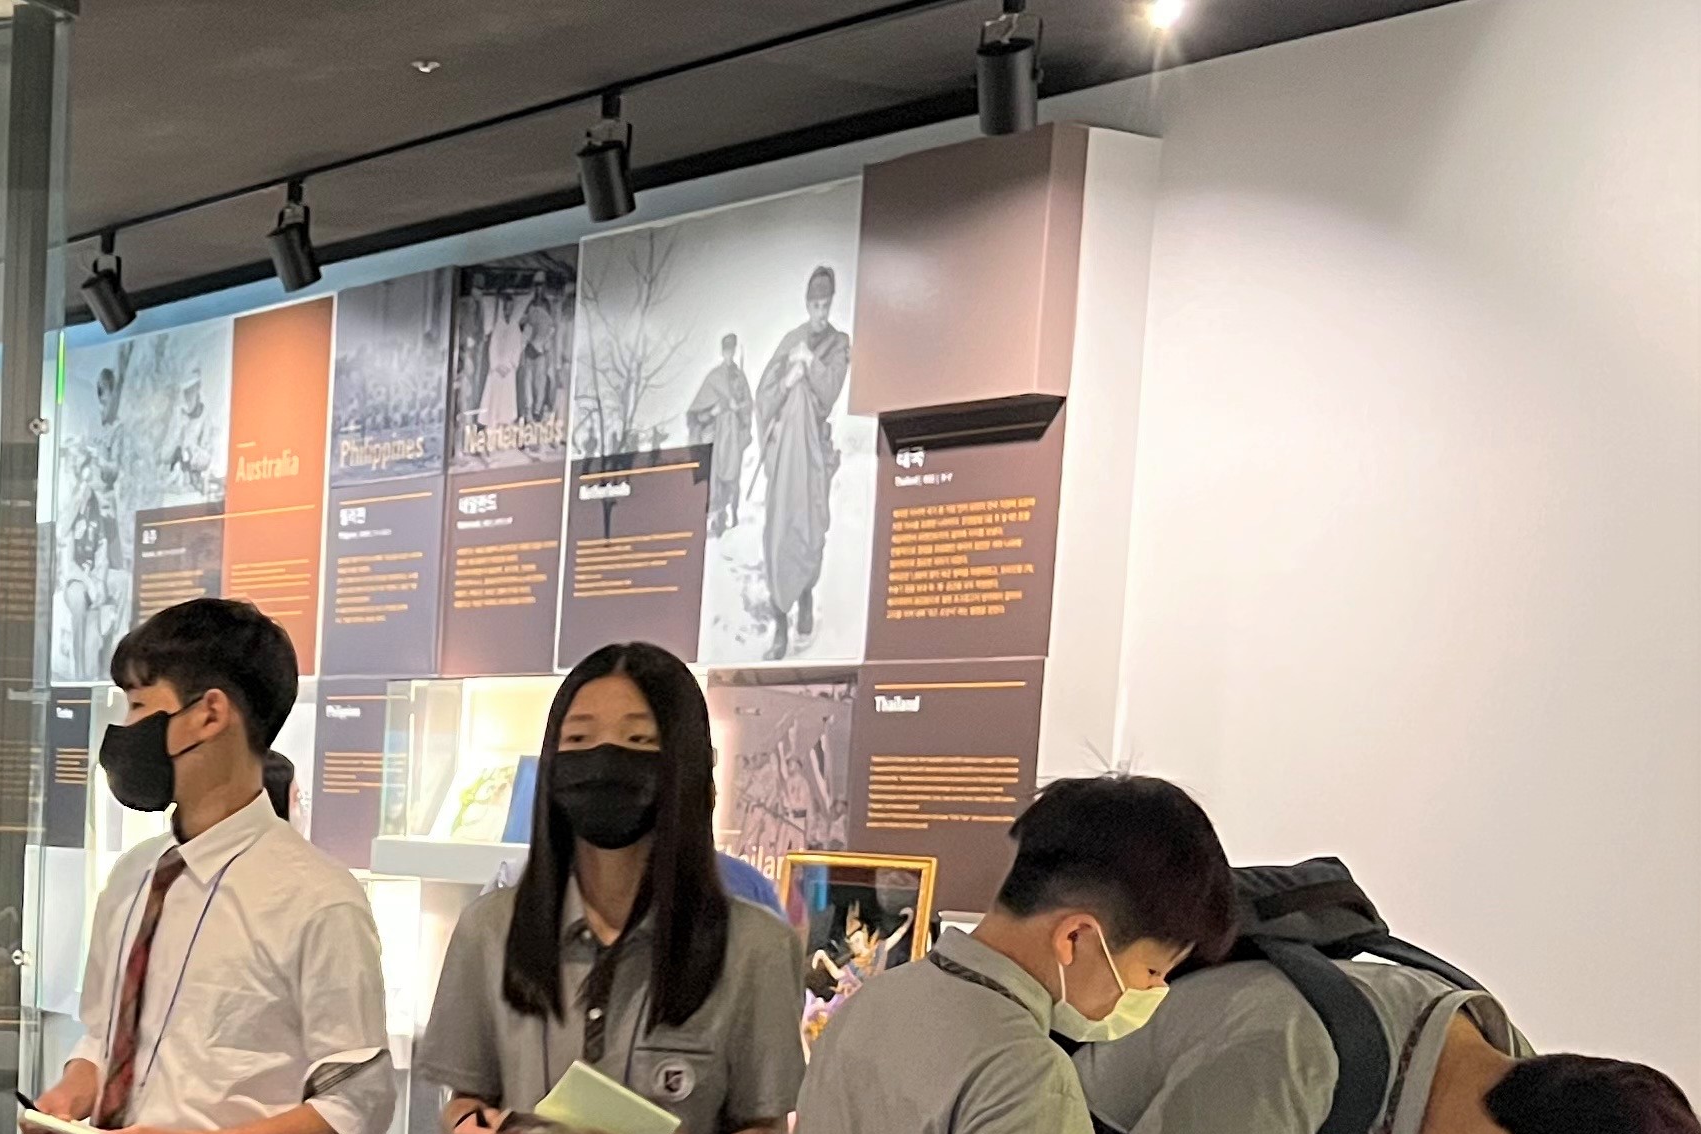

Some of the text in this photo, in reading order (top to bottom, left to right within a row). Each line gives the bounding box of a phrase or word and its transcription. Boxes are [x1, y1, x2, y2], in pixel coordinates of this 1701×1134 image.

[338, 432, 425, 471] Philippines
[463, 414, 565, 455] Netherlands
[235, 449, 300, 483] Australia
